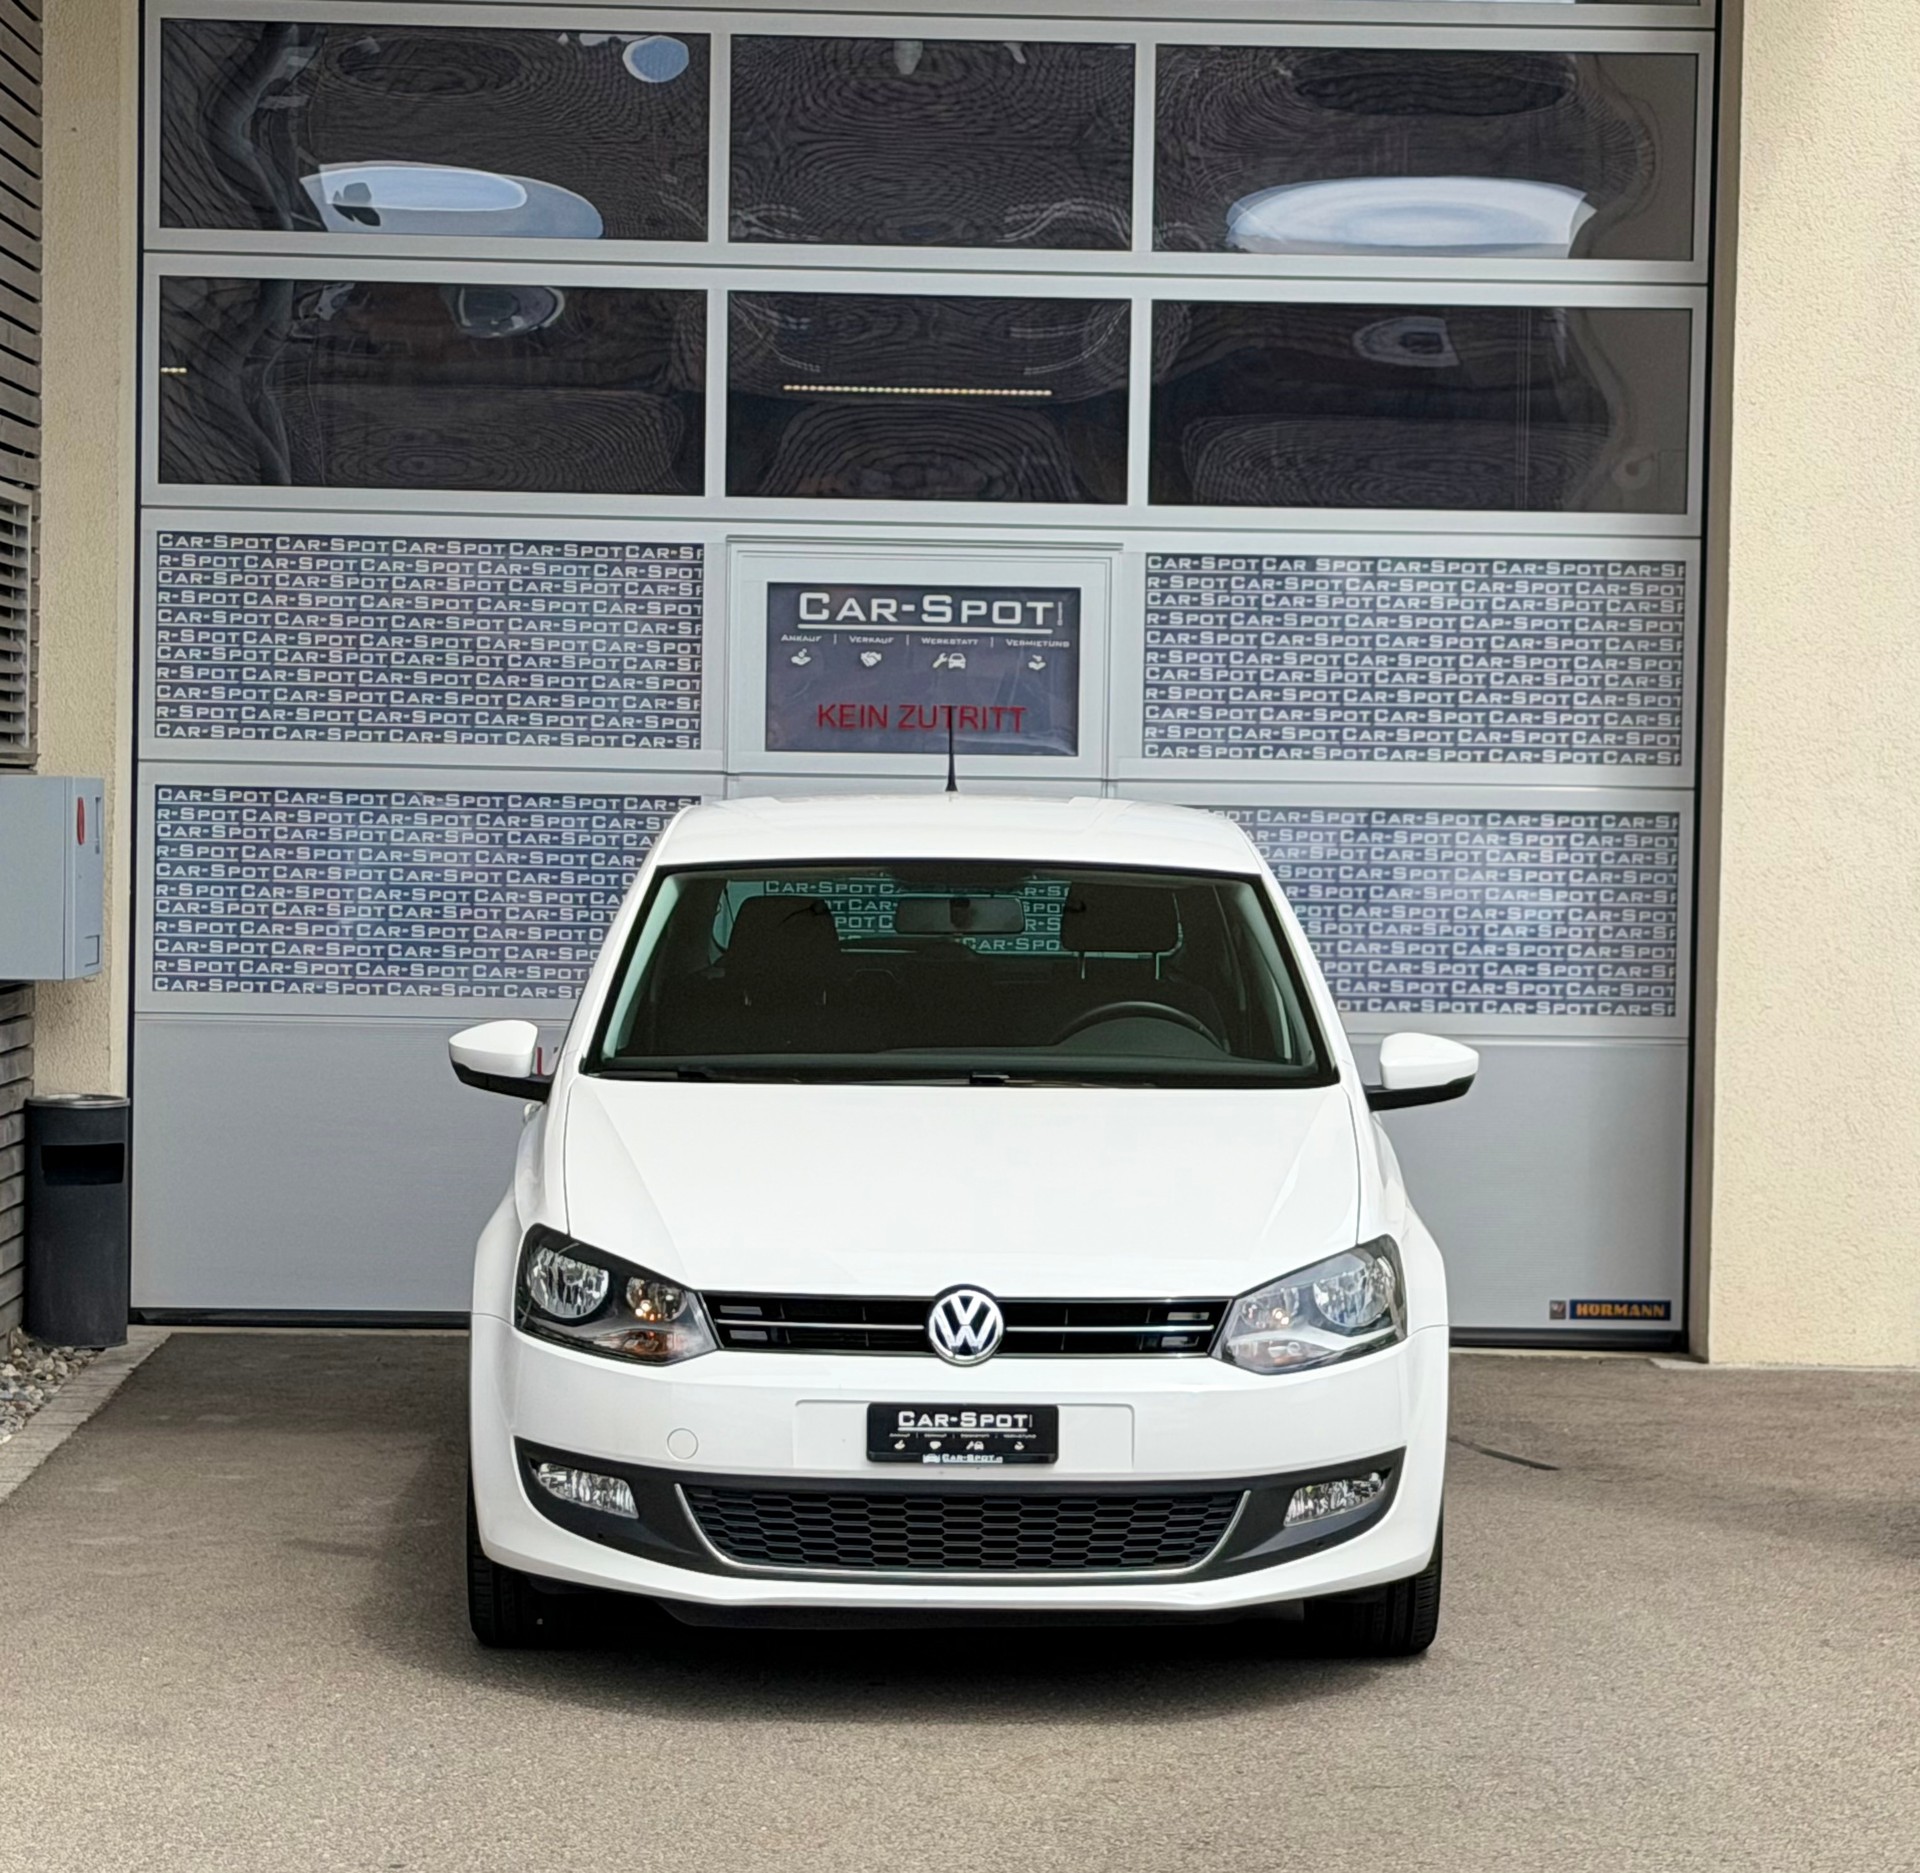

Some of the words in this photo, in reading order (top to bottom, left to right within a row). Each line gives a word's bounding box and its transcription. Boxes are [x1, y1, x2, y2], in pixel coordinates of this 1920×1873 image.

[799, 591, 1054, 626] CAR-SPOT
[817, 704, 888, 730] KEIN
[898, 705, 1027, 733] ZUTRITT
[962, 937, 1060, 951] CAR-SPO
[929, 1289, 1004, 1366] VW
[898, 1411, 1028, 1428] CAR-SPOT
